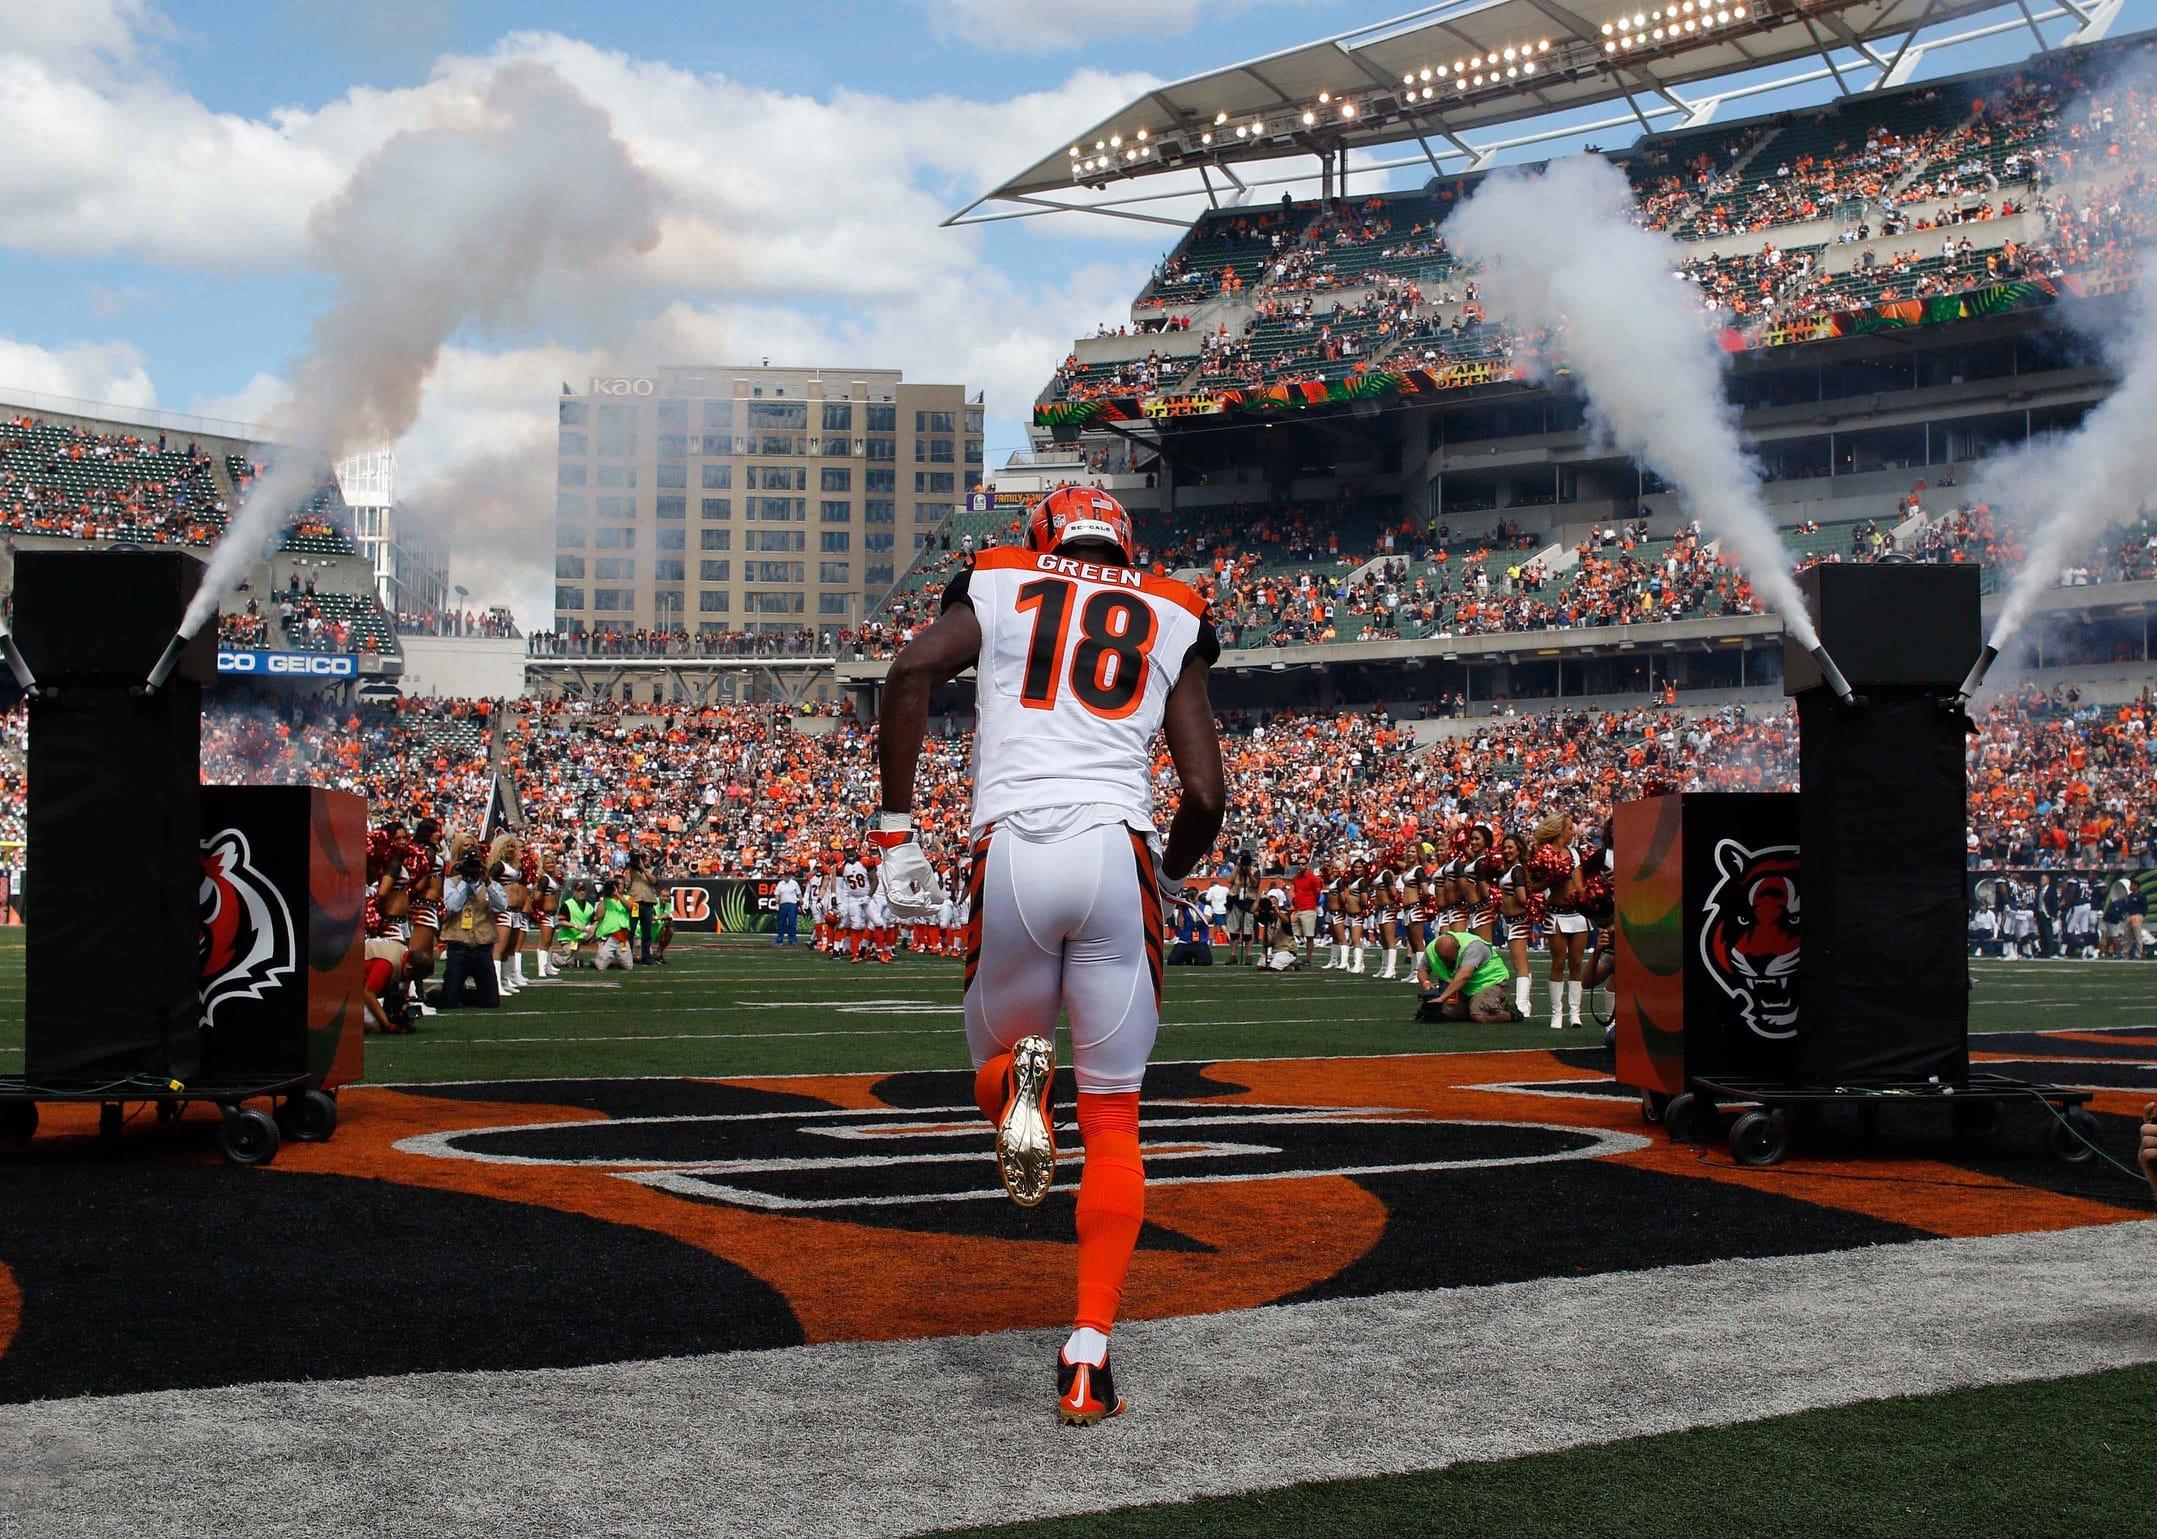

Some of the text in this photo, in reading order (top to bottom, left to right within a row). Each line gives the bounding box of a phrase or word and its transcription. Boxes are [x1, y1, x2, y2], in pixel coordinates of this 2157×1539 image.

[995, 494, 1024, 503] FAMILY
[1036, 554, 1141, 587] GREEN
[1015, 577, 1159, 720] 18
[268, 655, 351, 675] GEICO
[847, 873, 865, 890] 58
